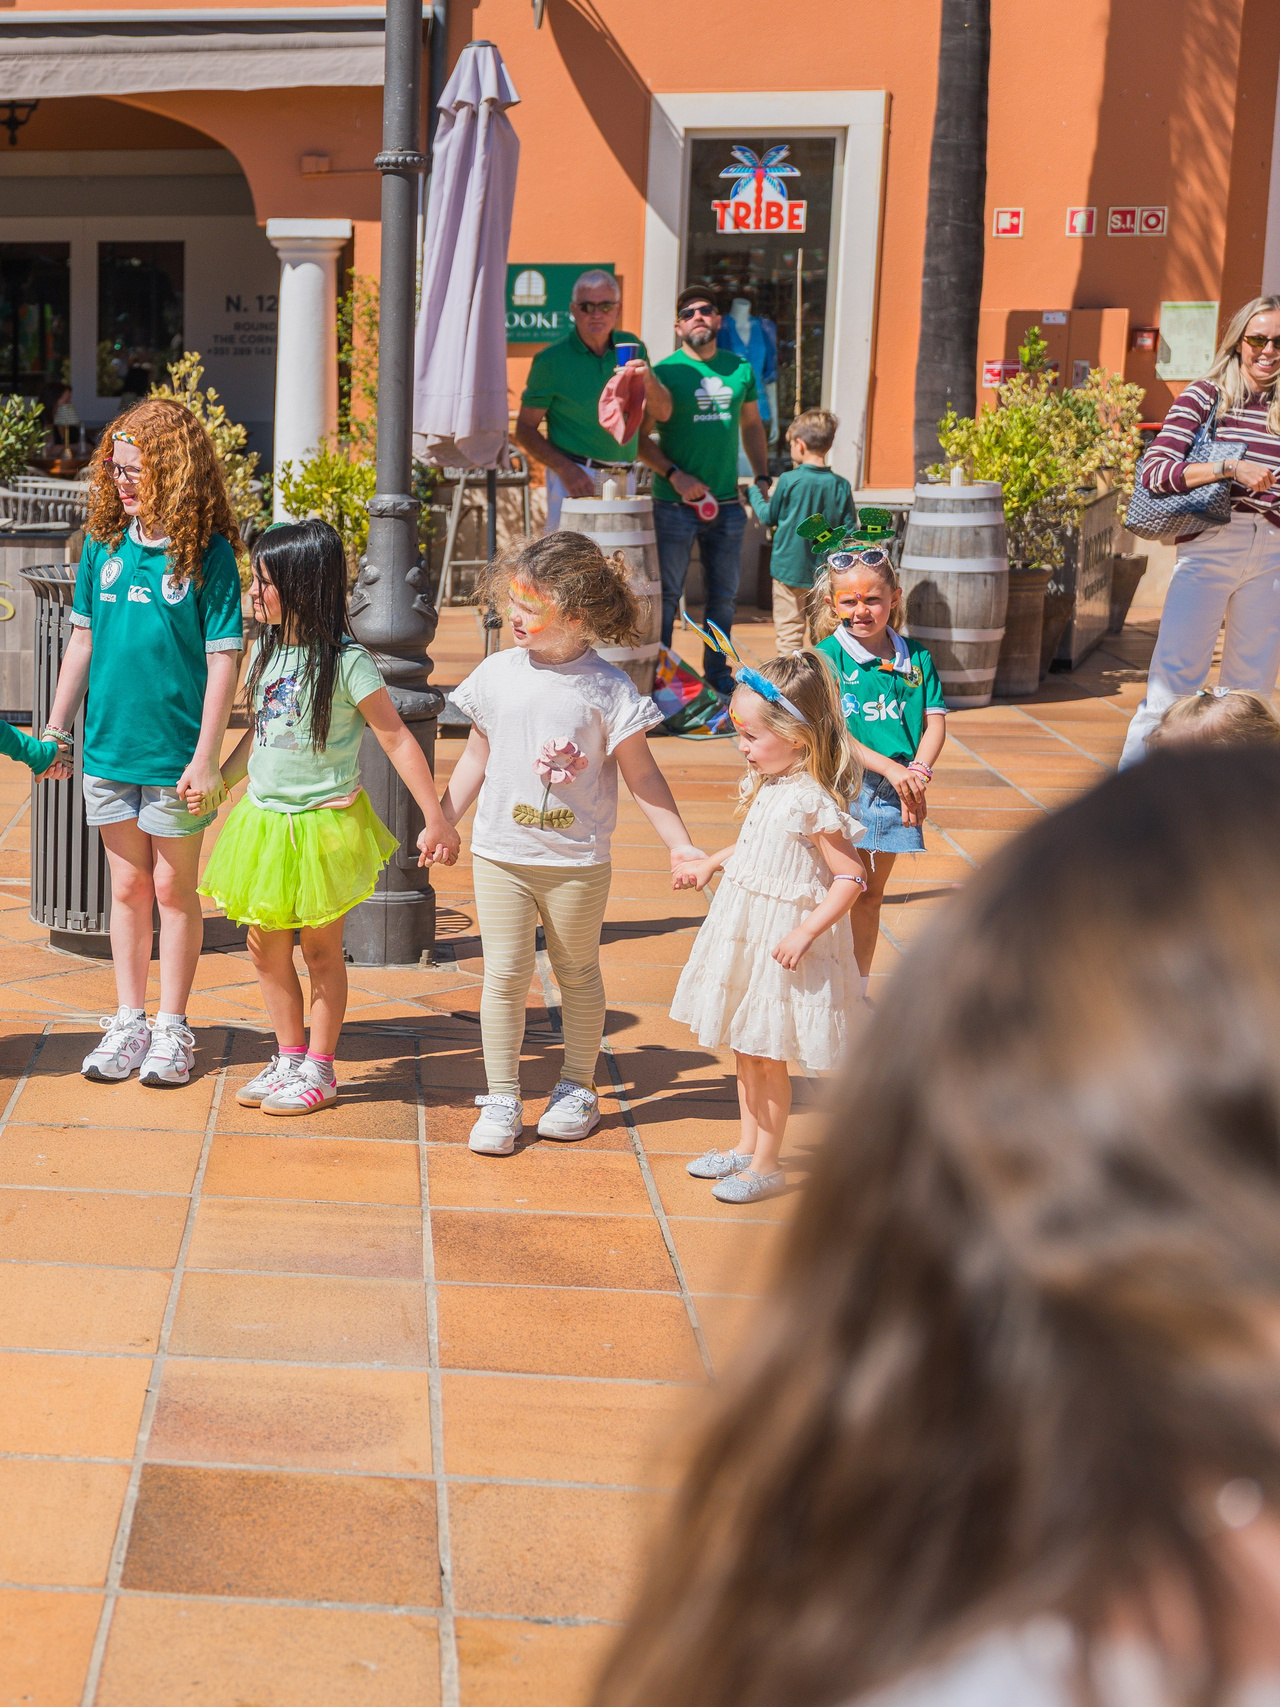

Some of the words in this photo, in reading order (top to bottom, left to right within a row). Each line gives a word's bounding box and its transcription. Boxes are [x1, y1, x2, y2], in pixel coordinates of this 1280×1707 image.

[713, 201, 804, 230] TRIBE
[225, 295, 248, 312] N.
[256, 295, 278, 312] 12
